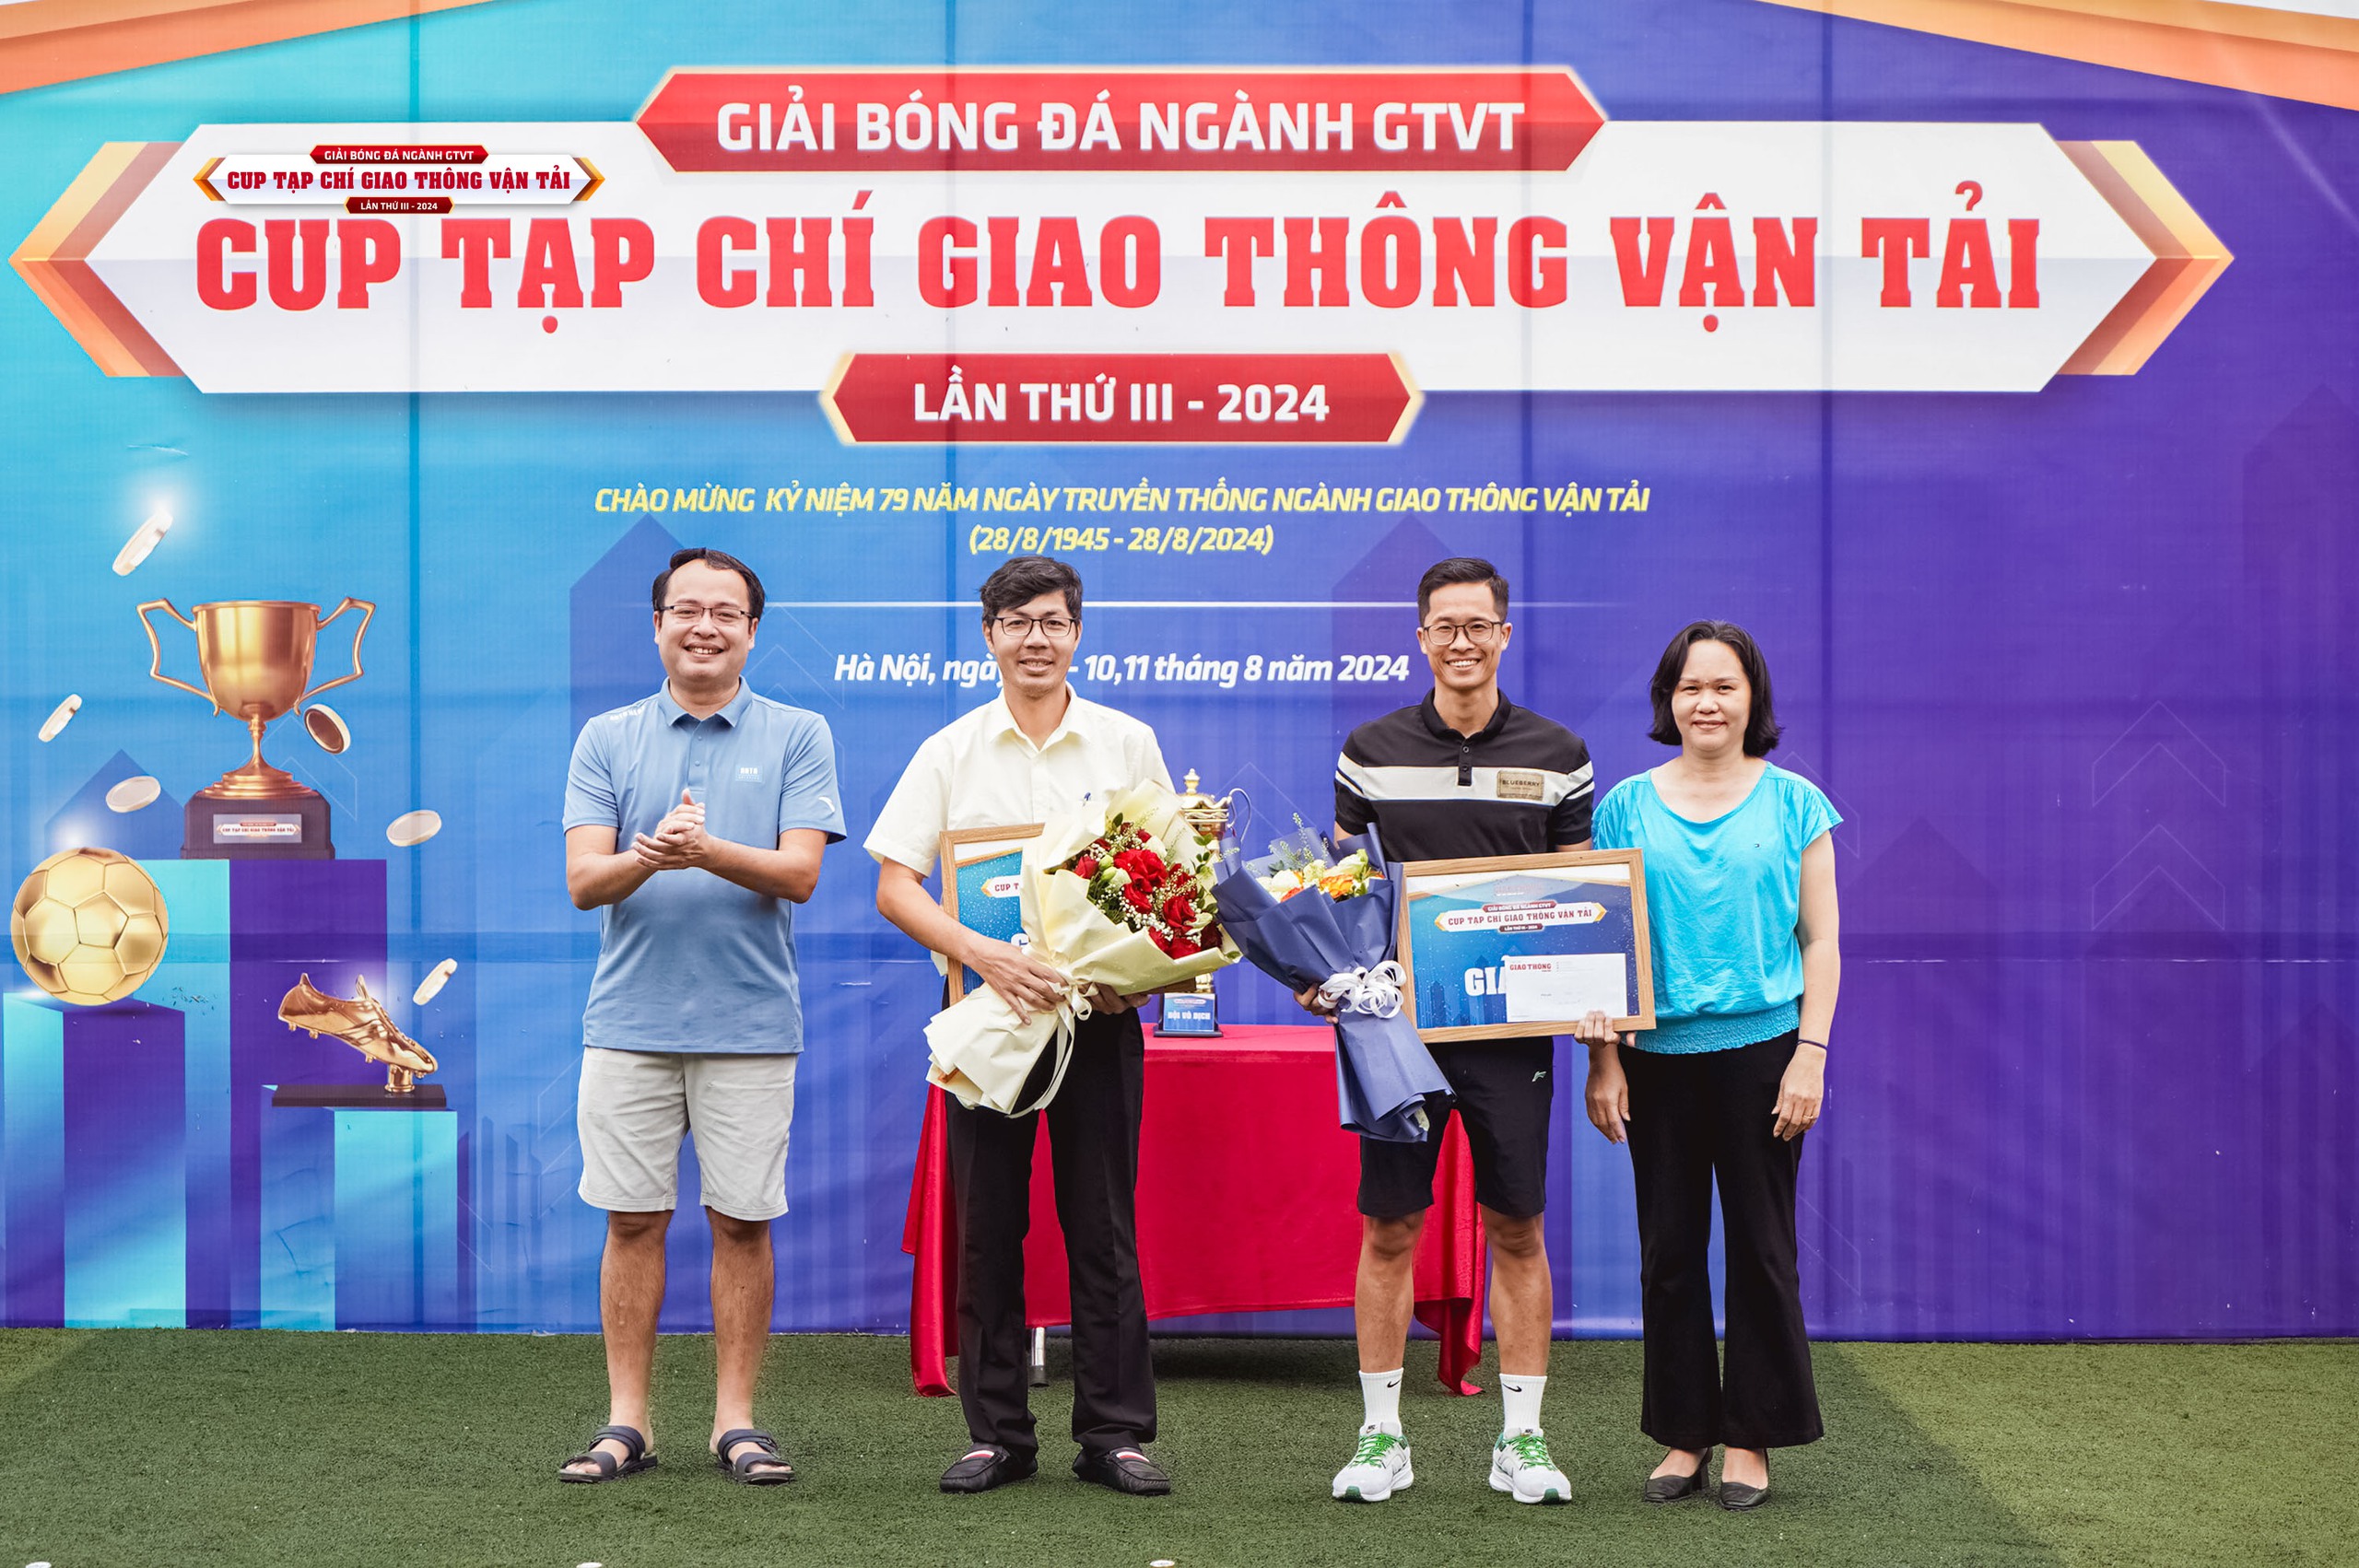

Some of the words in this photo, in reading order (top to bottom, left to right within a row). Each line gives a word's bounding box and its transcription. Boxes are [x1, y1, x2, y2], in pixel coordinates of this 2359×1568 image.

[718, 85, 835, 151] GIẢI
[856, 88, 1018, 151] BÓNG
[1037, 88, 1121, 151] ĐÁ
[1140, 88, 1354, 151] NGÀNH
[1373, 102, 1525, 151] GTVT
[195, 217, 401, 311] CUP
[440, 217, 654, 333] TẠP
[697, 191, 874, 309] CHÍ
[919, 216, 1161, 309] GIAO
[1204, 192, 1567, 309] THÔNG
[1610, 193, 1817, 333] VẬN
[1862, 181, 2039, 309] TẢI
[914, 365, 1006, 422] LẦN
[1019, 372, 1117, 422] THỨ
[1130, 383, 1173, 421] III
[1188, 401, 1204, 410] -
[1217, 384, 1330, 422] 2024
[594, 482, 669, 512] CHÀO
[672, 481, 756, 512] MỪNG
[765, 479, 804, 512] KỶ
[804, 482, 874, 517] NIỆM
[878, 488, 909, 511] 79
[912, 482, 979, 511] NĂM
[982, 481, 1061, 511] NGÀY
[1062, 476, 1170, 511] TRUYỀN
[1175, 476, 1268, 511] THỐNG
[1272, 481, 1372, 511] NGÀNH
[1376, 487, 1441, 512] GIAO
[1445, 481, 1538, 512] THÔNG
[1543, 481, 1602, 517] VẬN
[1606, 479, 1650, 512] TẢI
[969, 524, 1110, 555] (28/8/1945
[1127, 524, 1274, 556] 28/8/2024)
[834, 653, 874, 681] Hà
[879, 651, 936, 687] Nội,
[1084, 654, 1150, 685] 10,11
[1154, 652, 1239, 689] tháng
[1244, 655, 1263, 681] 8
[1267, 654, 1333, 681] năm
[1337, 655, 1410, 681] 2024
[994, 883, 1011, 892] CUP
[1448, 918, 1464, 926] CUP
[1504, 913, 1524, 922] GIAO
